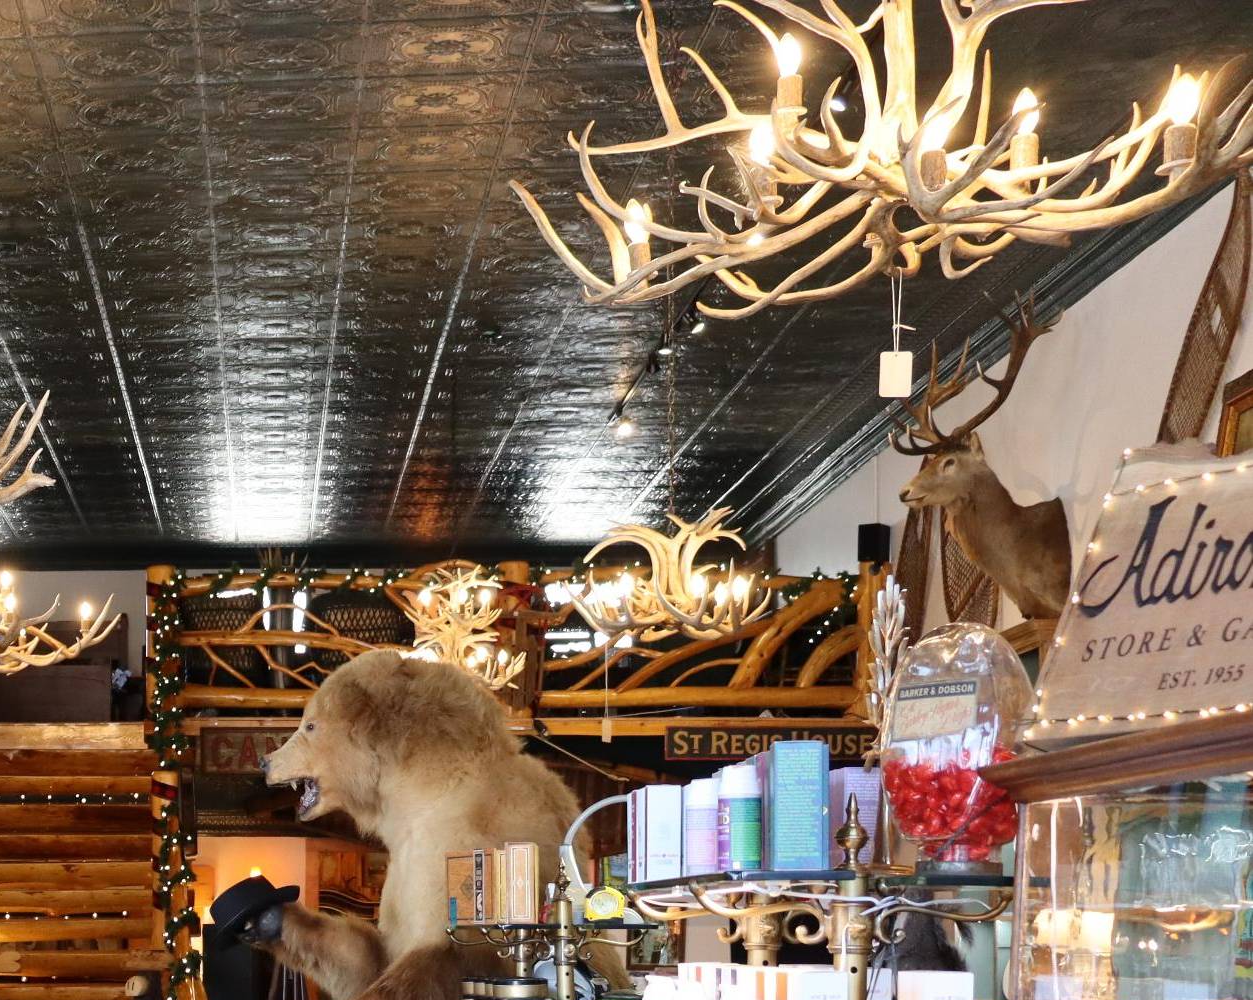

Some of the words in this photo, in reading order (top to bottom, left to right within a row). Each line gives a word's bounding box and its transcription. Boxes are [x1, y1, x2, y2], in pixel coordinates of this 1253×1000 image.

[1079, 495, 1253, 618] Adiro
[1081, 627, 1177, 663] STORE
[1186, 624, 1207, 648] &
[899, 687, 930, 698] BARKER
[937, 683, 974, 695] DOBSON
[1156, 669, 1197, 691] EST.
[1203, 663, 1246, 686] 1955
[790, 731, 877, 755] USE
